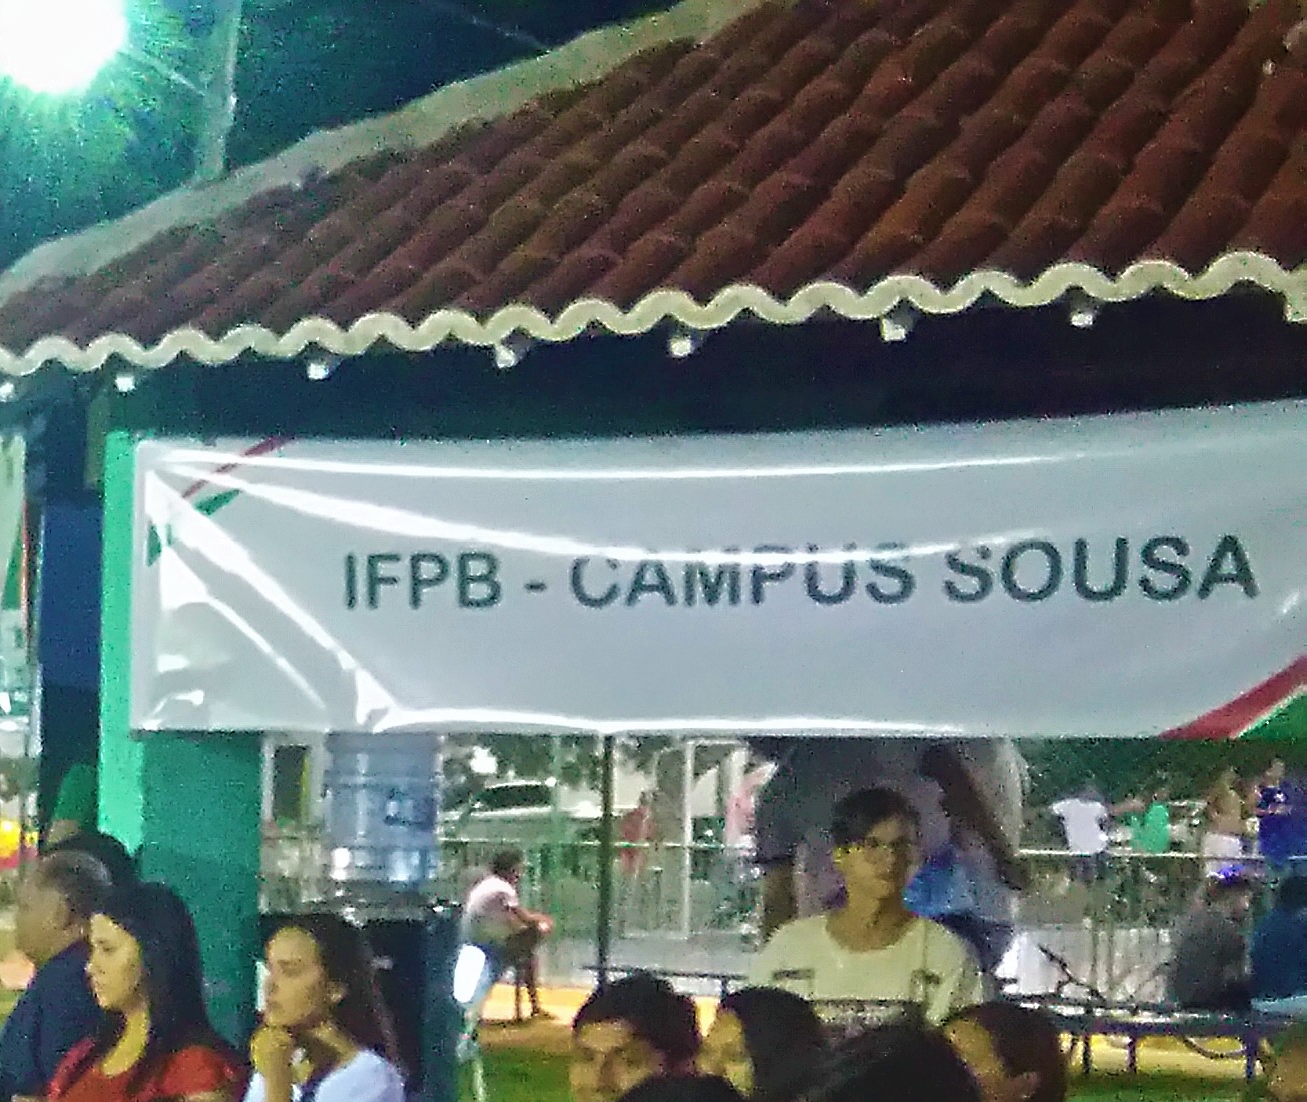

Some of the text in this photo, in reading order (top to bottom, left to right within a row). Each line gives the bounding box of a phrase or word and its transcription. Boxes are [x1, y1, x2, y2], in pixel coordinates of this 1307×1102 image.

[345, 534, 1261, 609] IFPB - CAMPUS SOUSA
